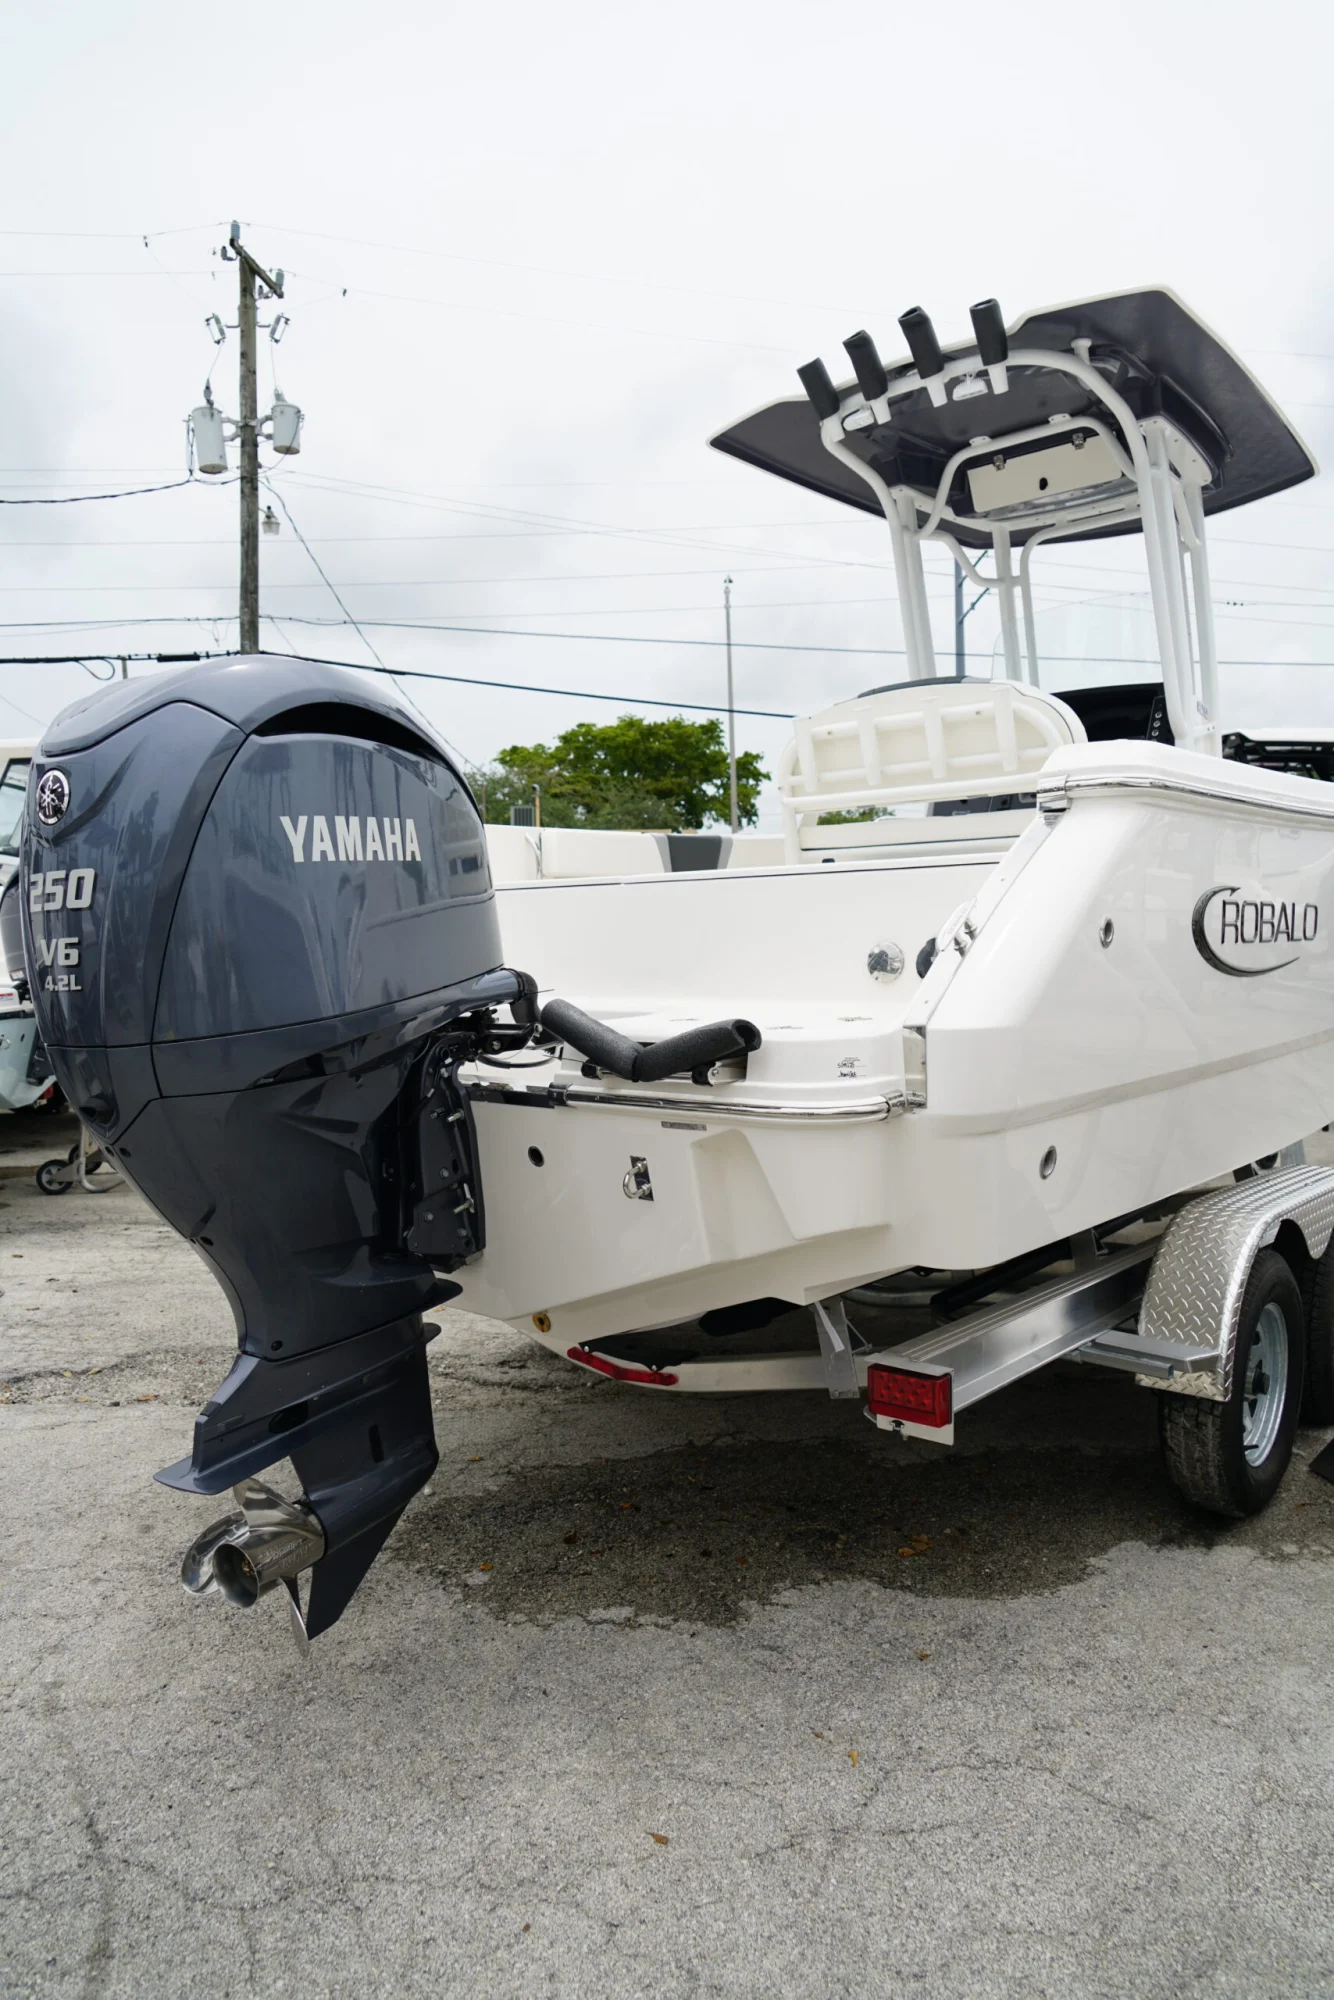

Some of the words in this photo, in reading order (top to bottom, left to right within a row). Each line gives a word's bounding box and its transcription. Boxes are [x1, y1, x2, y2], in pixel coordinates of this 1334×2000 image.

[279, 815, 422, 863] YAMAHA
[30, 868, 96, 913] 250
[1220, 899, 1319, 945] ROBALO
[40, 936, 80, 967] V6
[44, 974, 82, 991] 4.2L
